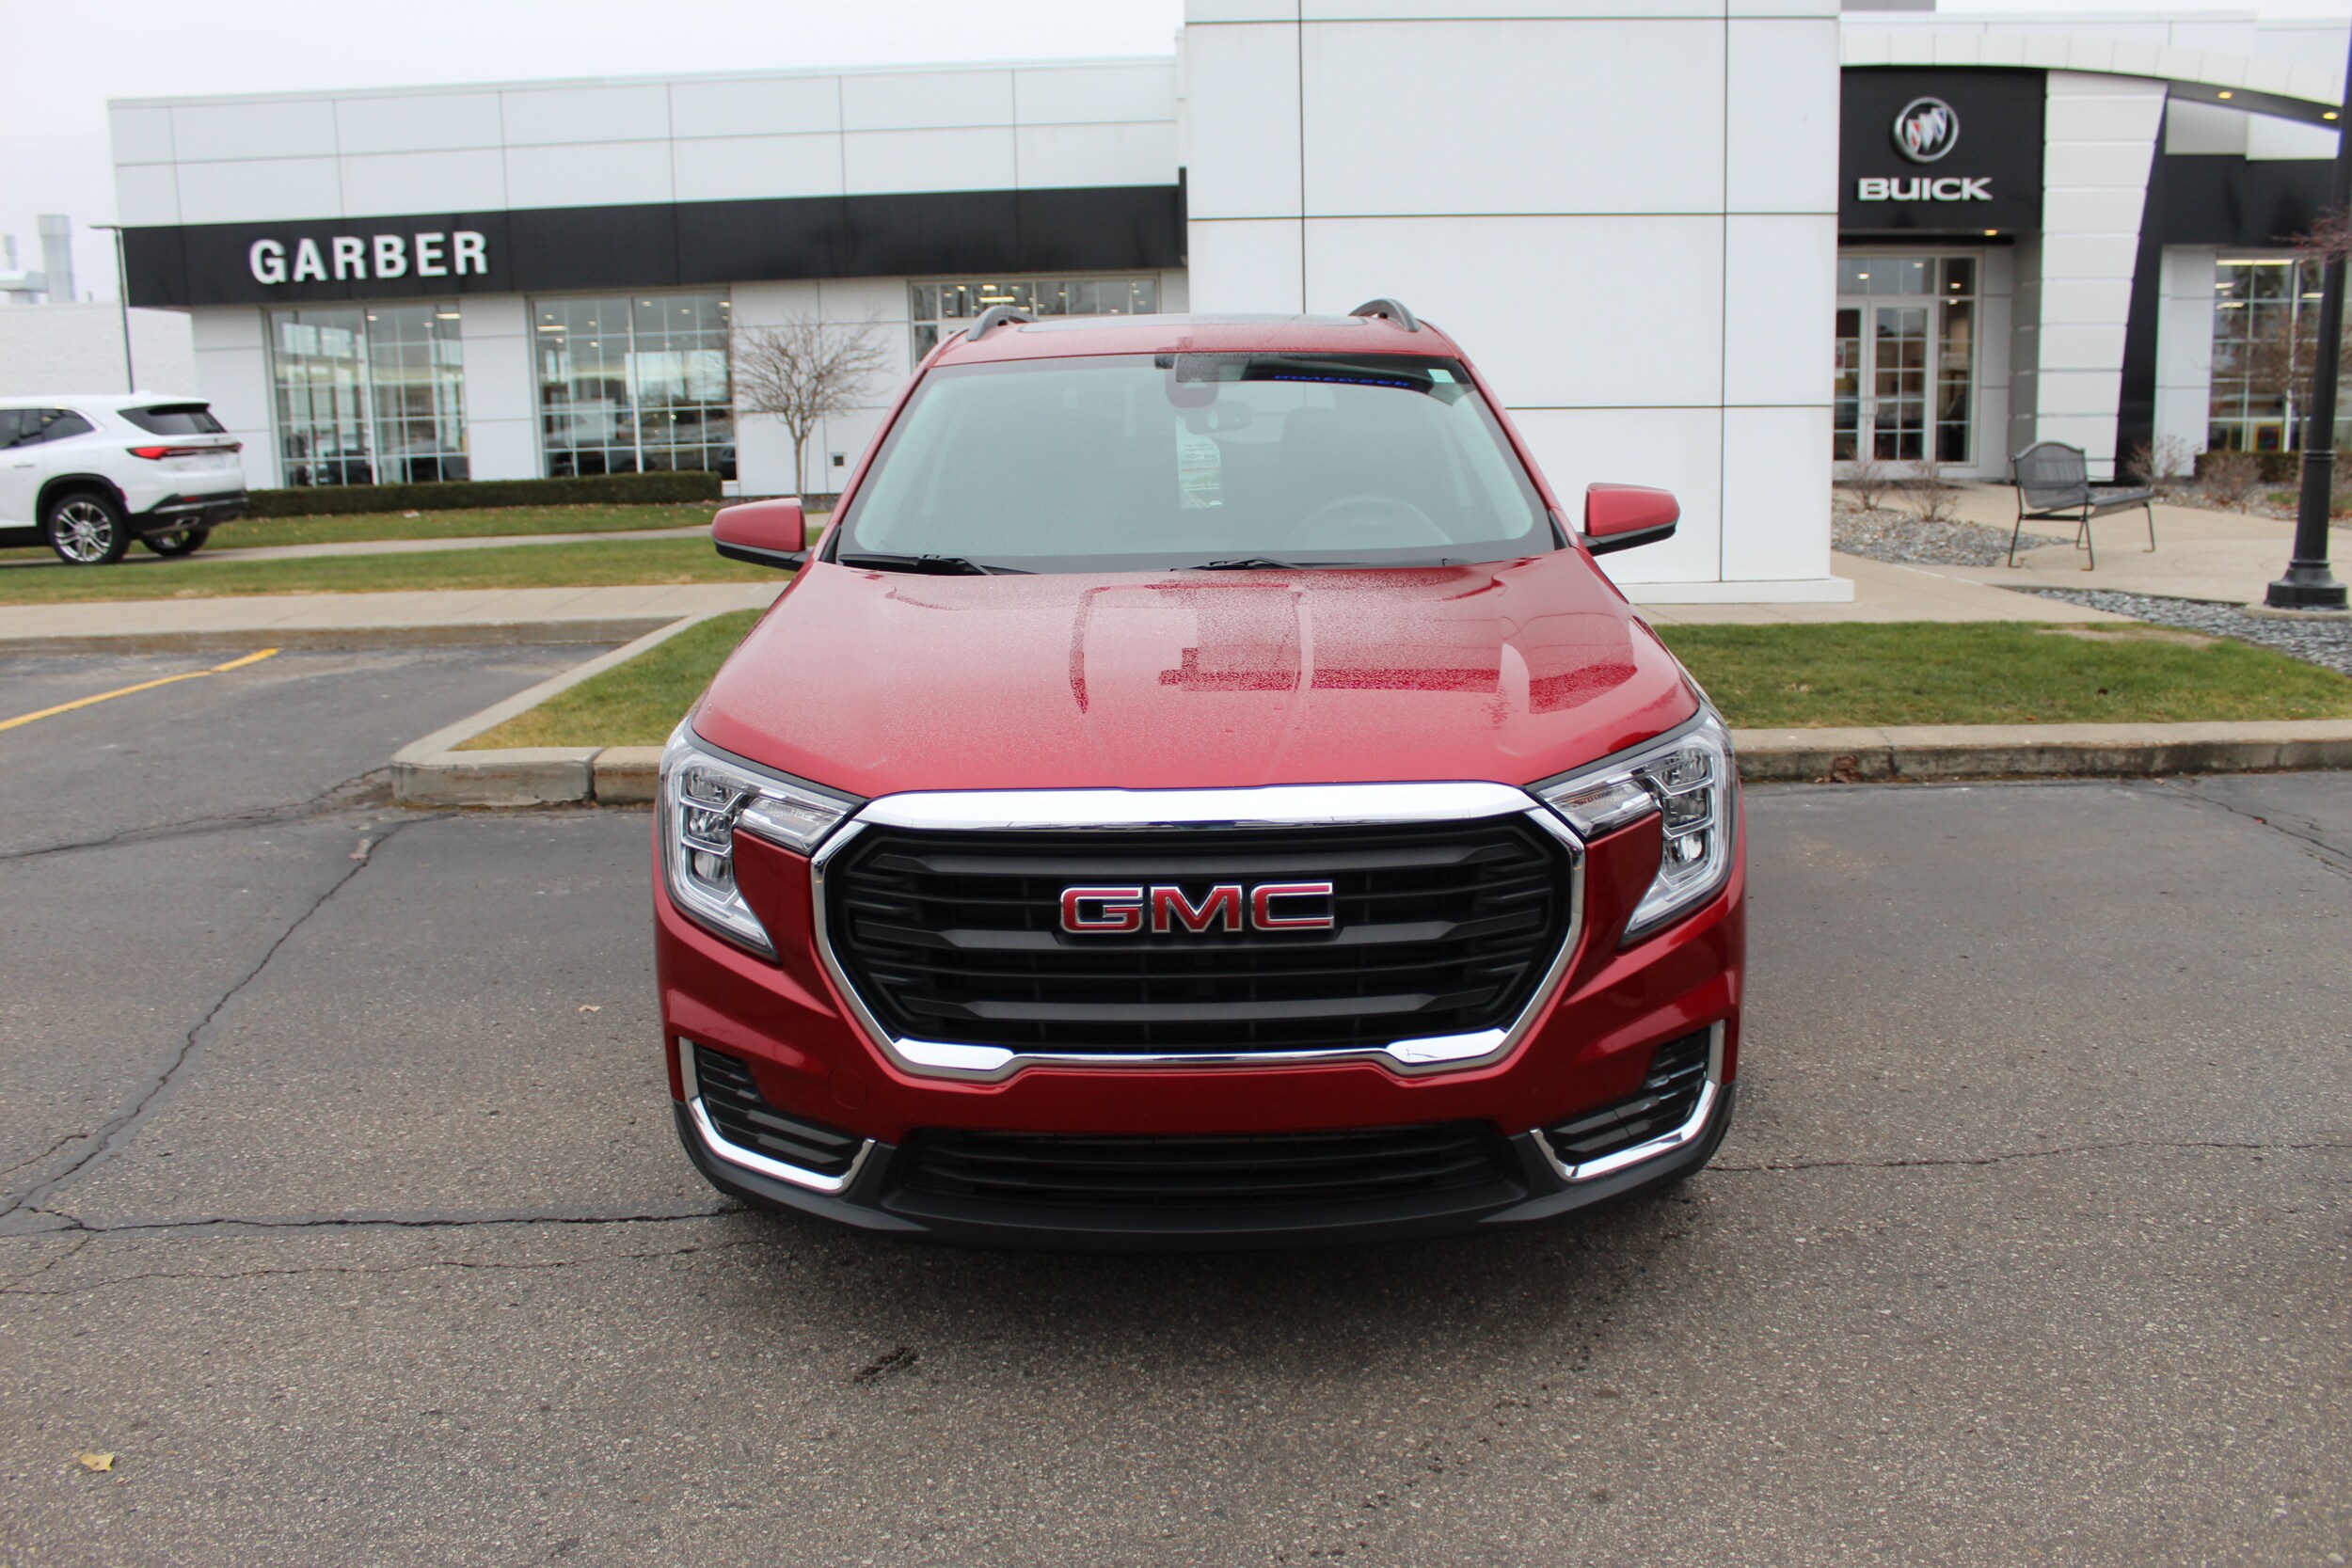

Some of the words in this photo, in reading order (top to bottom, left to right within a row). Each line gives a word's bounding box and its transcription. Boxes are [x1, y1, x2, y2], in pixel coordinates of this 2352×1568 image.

[1858, 177, 1994, 201] BUICK
[249, 231, 488, 284] GARBER
[1060, 882, 1334, 933] GMC
